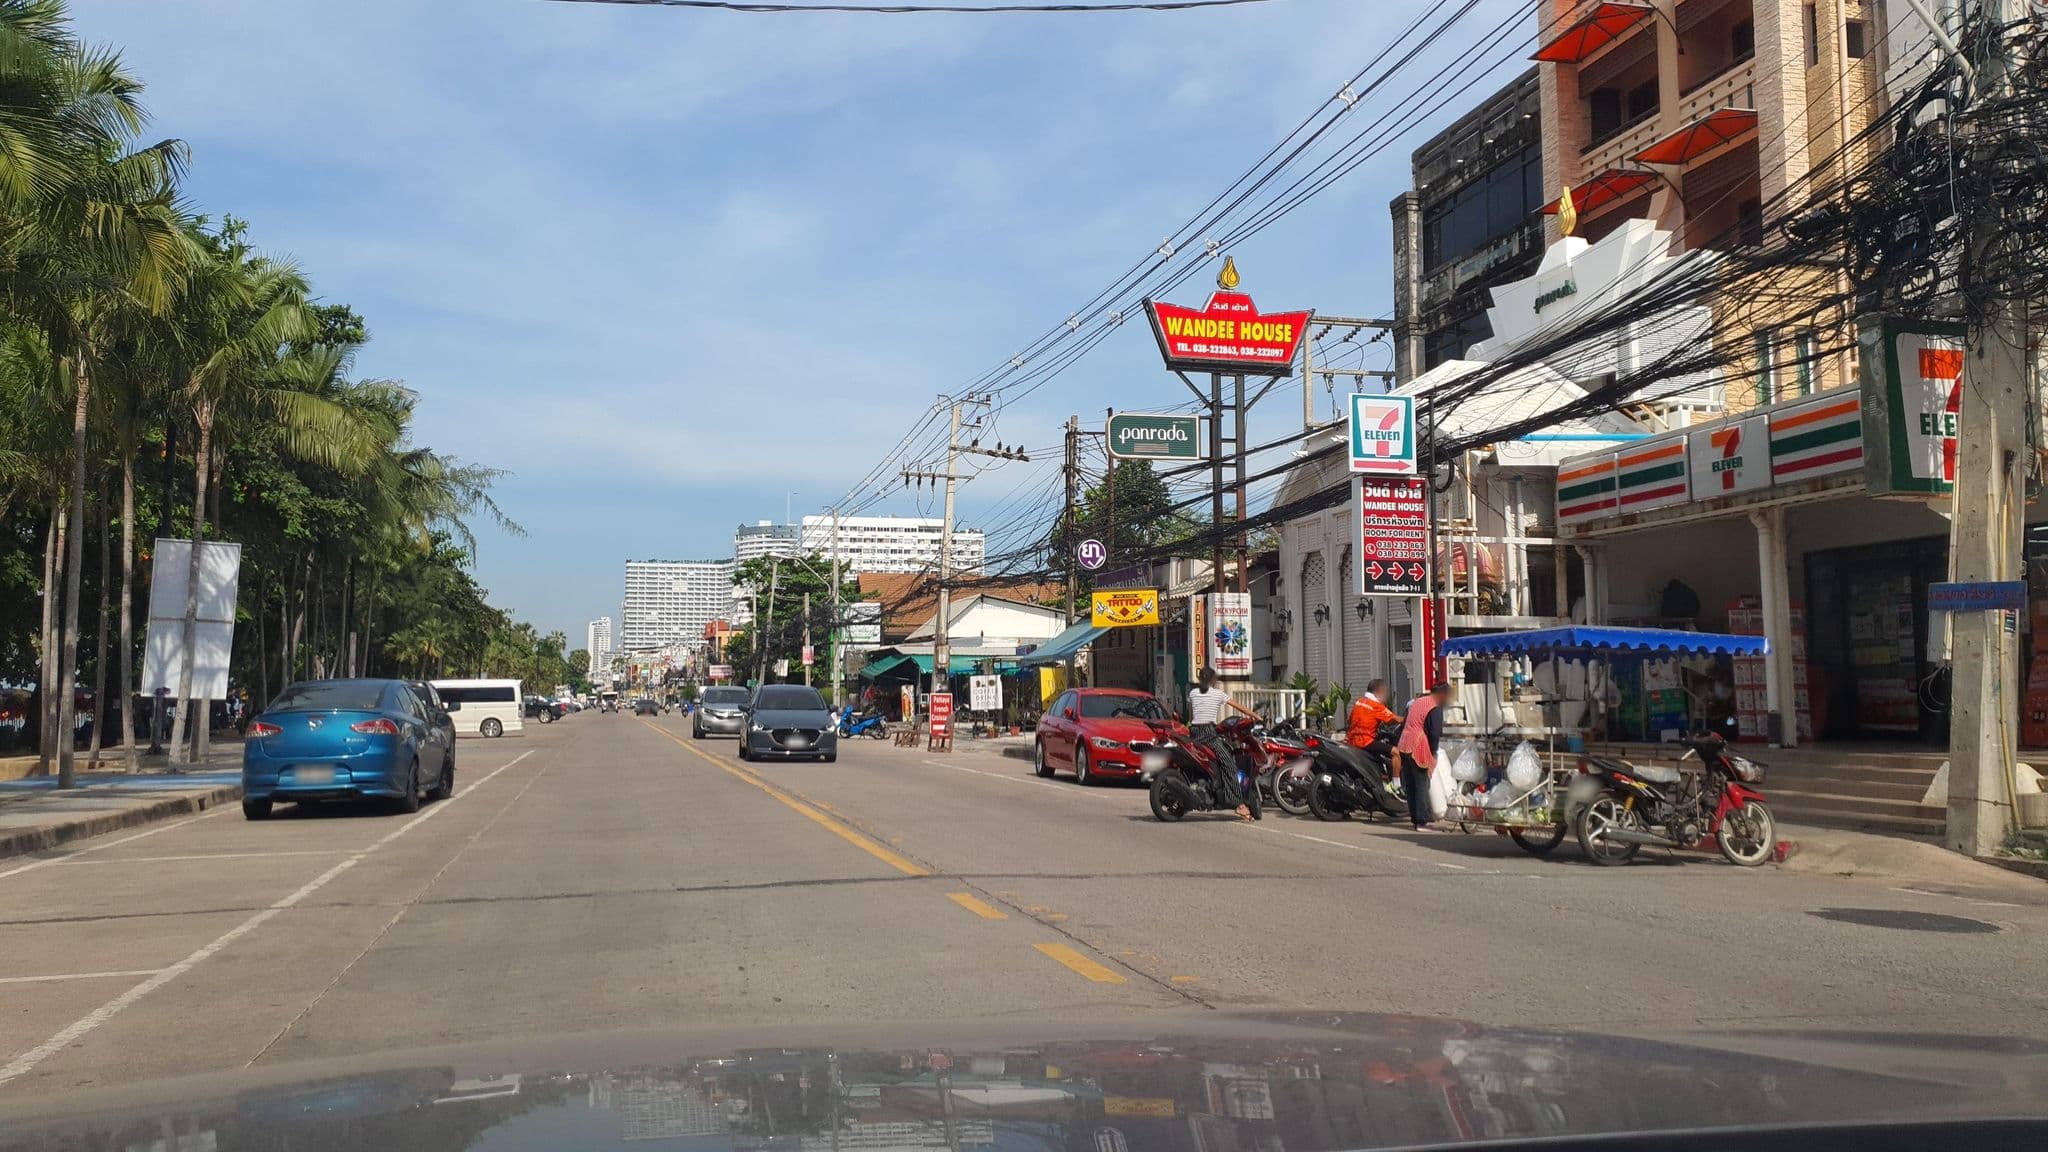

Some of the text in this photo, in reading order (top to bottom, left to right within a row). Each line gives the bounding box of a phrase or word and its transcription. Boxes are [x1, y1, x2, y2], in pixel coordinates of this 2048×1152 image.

[1166, 317, 1292, 343] WANDEE HOUSE
[1176, 342, 1191, 352] TEL.
[1366, 406, 1399, 456] 7
[1920, 413, 1957, 436] ELE
[1119, 424, 1188, 444] panrada
[1711, 427, 1740, 490] 7
[1365, 482, 1390, 498] วันดี
[1364, 502, 1424, 512] WANDEE HOUSE
[1365, 529, 1424, 538] ROOM FOR RENT
[1376, 541, 1392, 549] 038
[1393, 541, 1408, 549] 232
[1377, 550, 1393, 558] 038
[1394, 550, 1409, 558] 232
